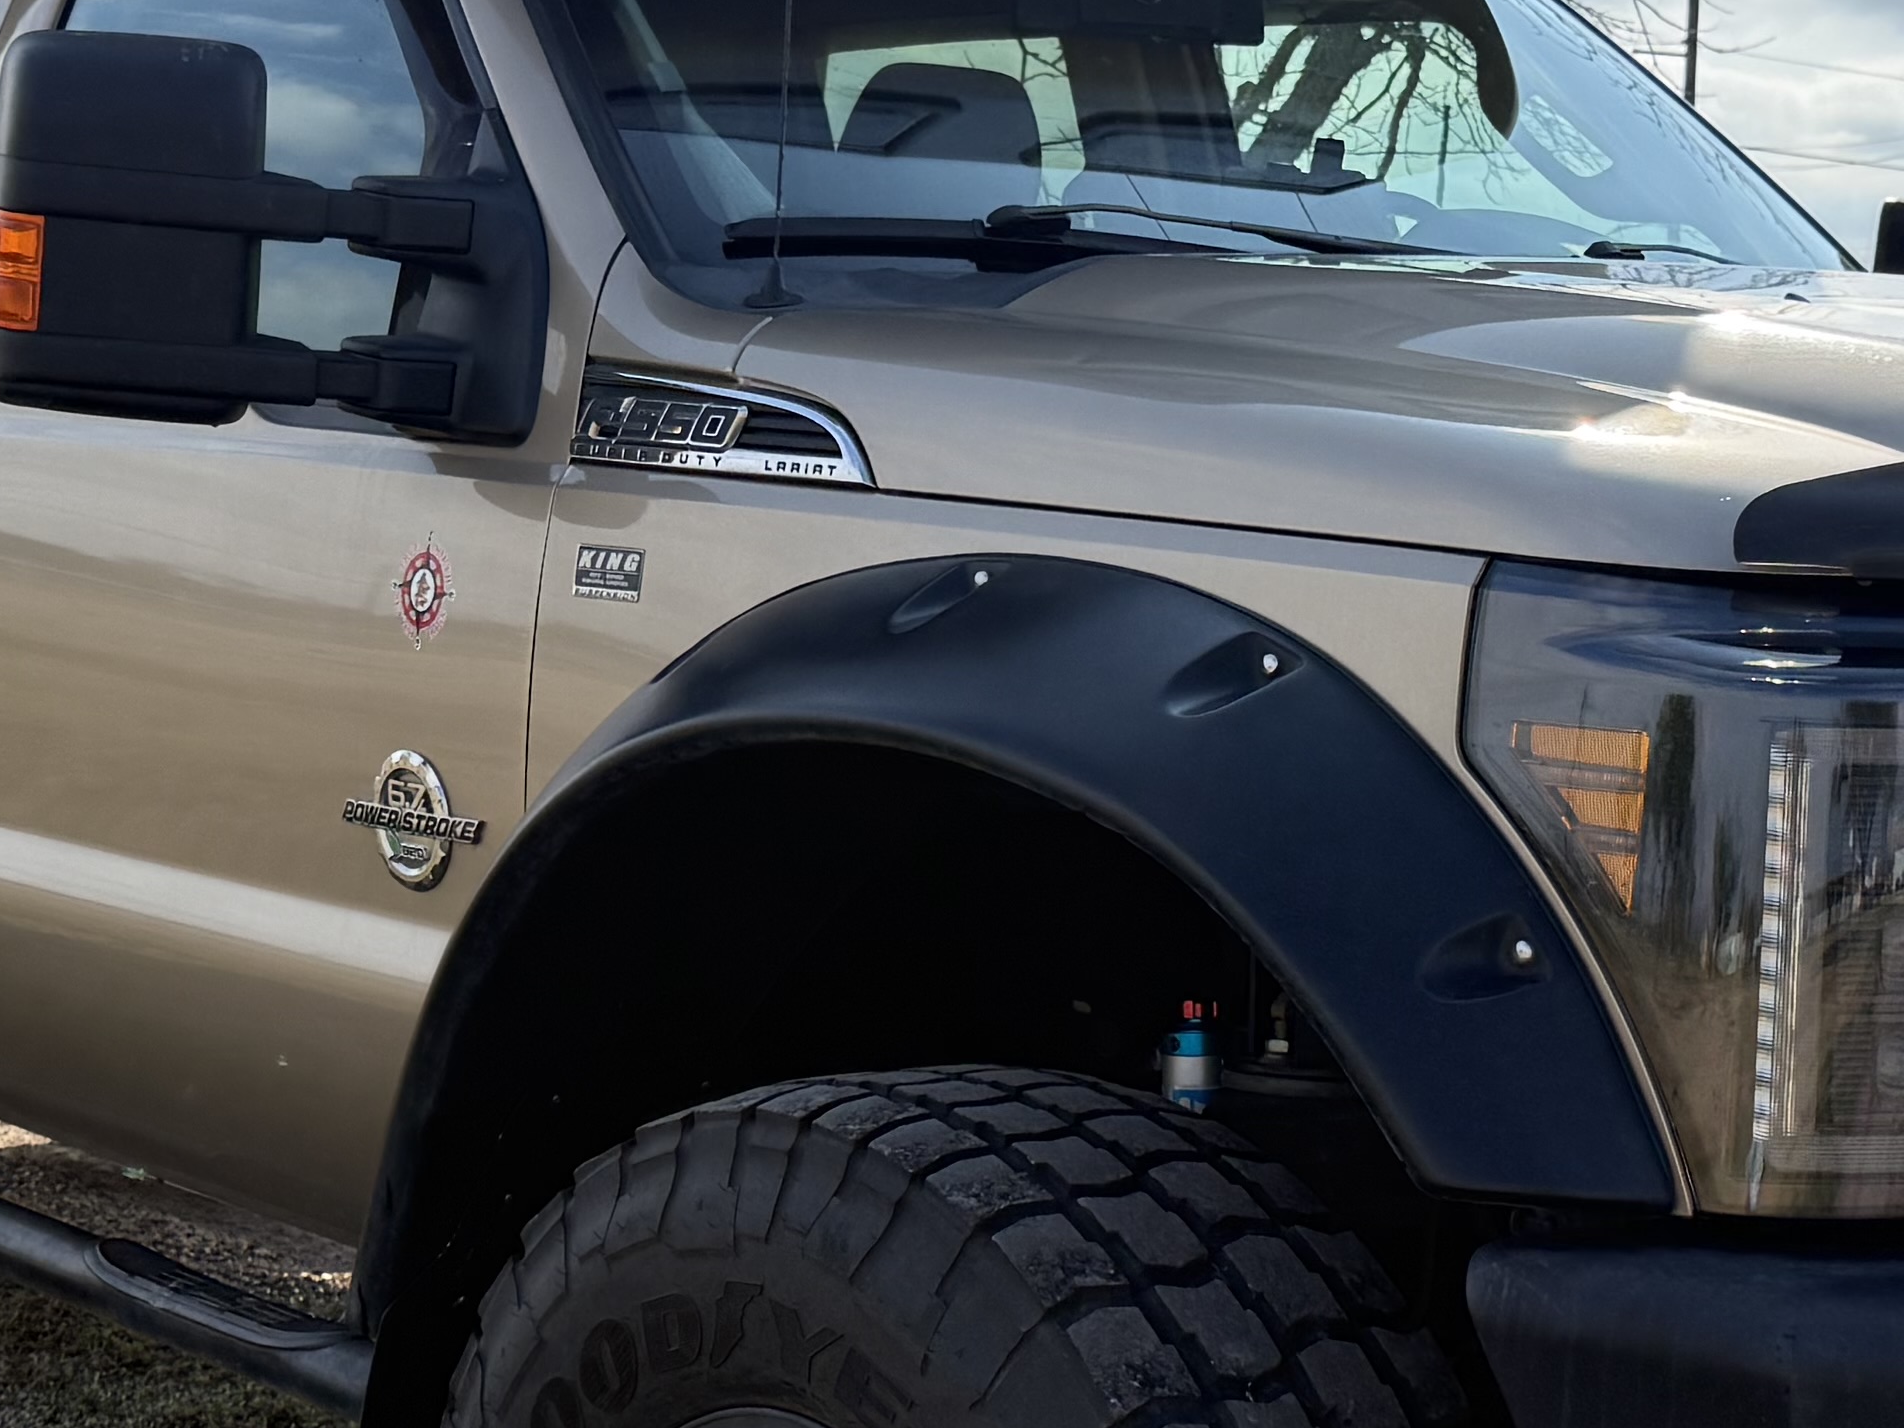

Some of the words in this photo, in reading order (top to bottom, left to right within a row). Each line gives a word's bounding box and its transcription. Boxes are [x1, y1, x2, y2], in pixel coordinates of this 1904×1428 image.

[659, 450, 723, 467] DUTY
[764, 459, 838, 477] LARIAT
[578, 550, 641, 572] KING
[344, 801, 401, 830] POWER
[401, 810, 476, 843] STROKE
